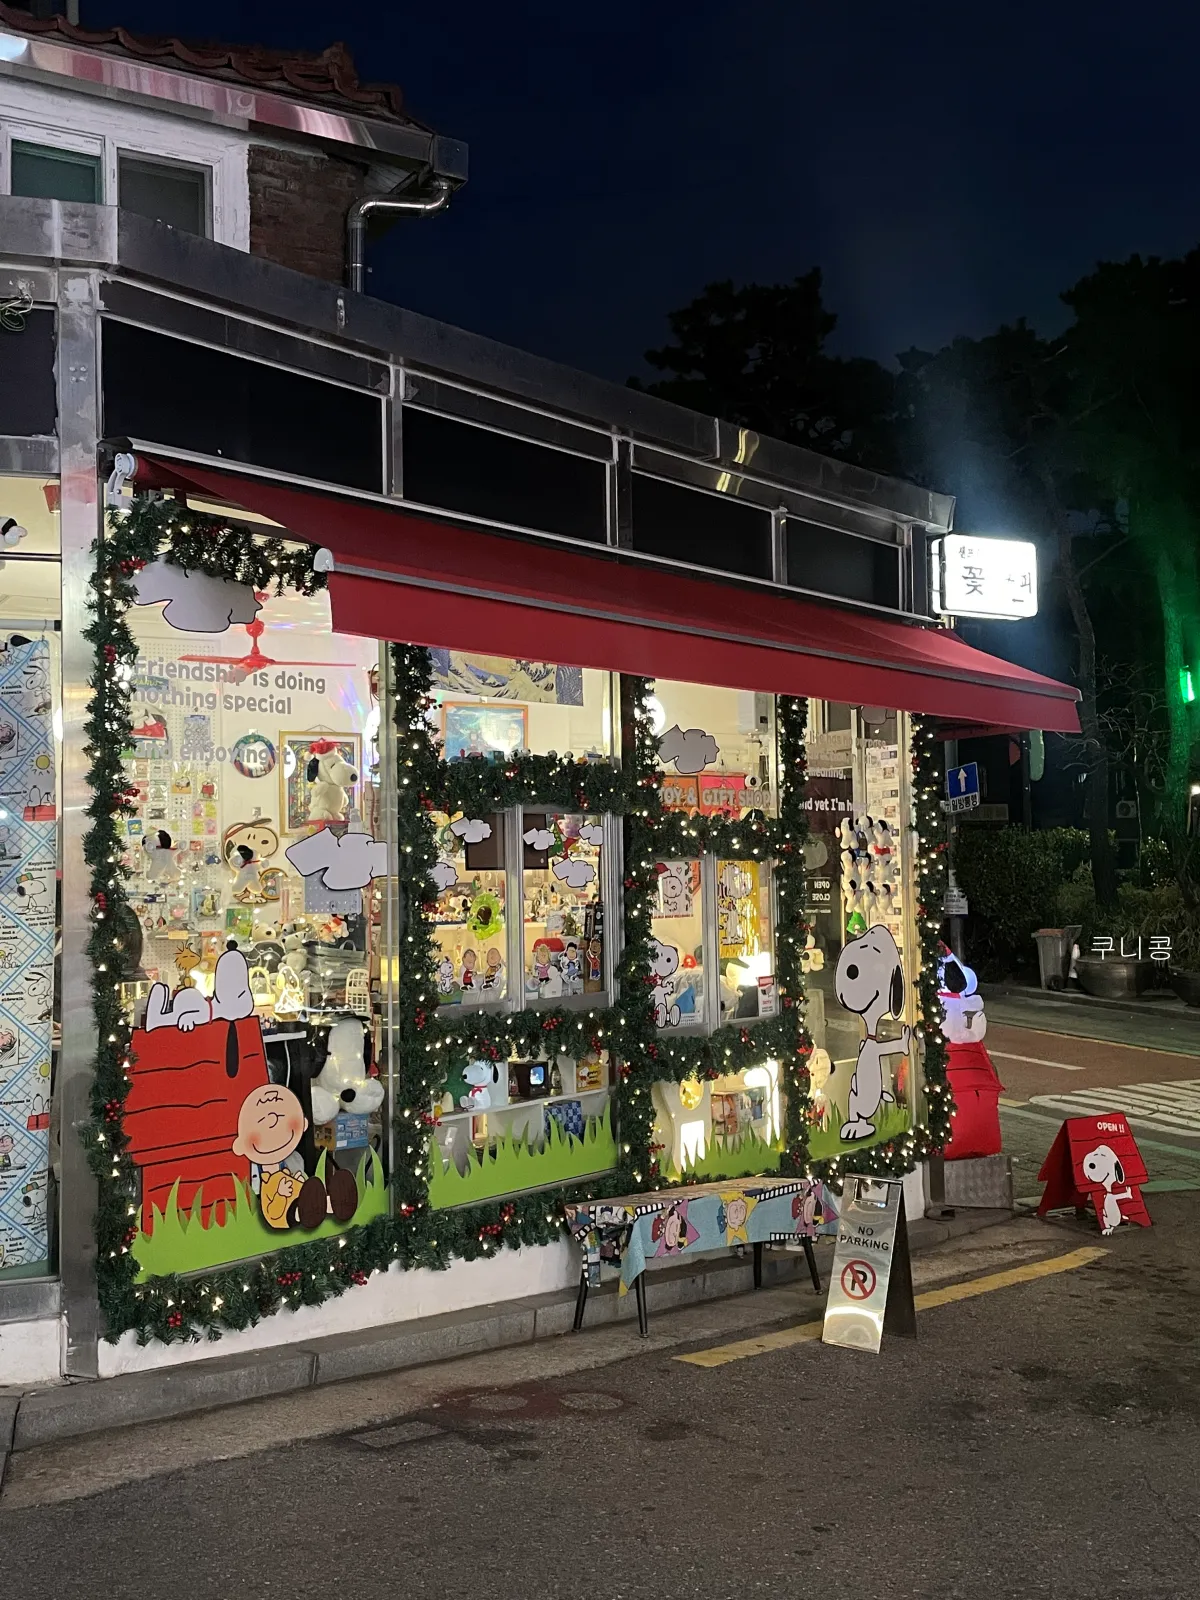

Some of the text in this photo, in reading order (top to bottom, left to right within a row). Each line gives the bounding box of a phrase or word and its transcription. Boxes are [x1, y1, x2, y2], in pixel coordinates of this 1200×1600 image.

[962, 566, 985, 595] 꽃
[135, 656, 246, 686] Friendship
[253, 667, 269, 687] is
[275, 671, 325, 694] doing
[133, 684, 292, 715] nothing special
[134, 740, 172, 761] and
[180, 742, 267, 765] enjoying
[659, 786, 772, 808] TOY & GIFT SHOP
[814, 798, 829, 811] yet
[831, 797, 845, 811] I'm
[1097, 1121, 1118, 1131] OPEN
[858, 1226, 874, 1236] NO
[840, 1235, 889, 1251] PARKING
